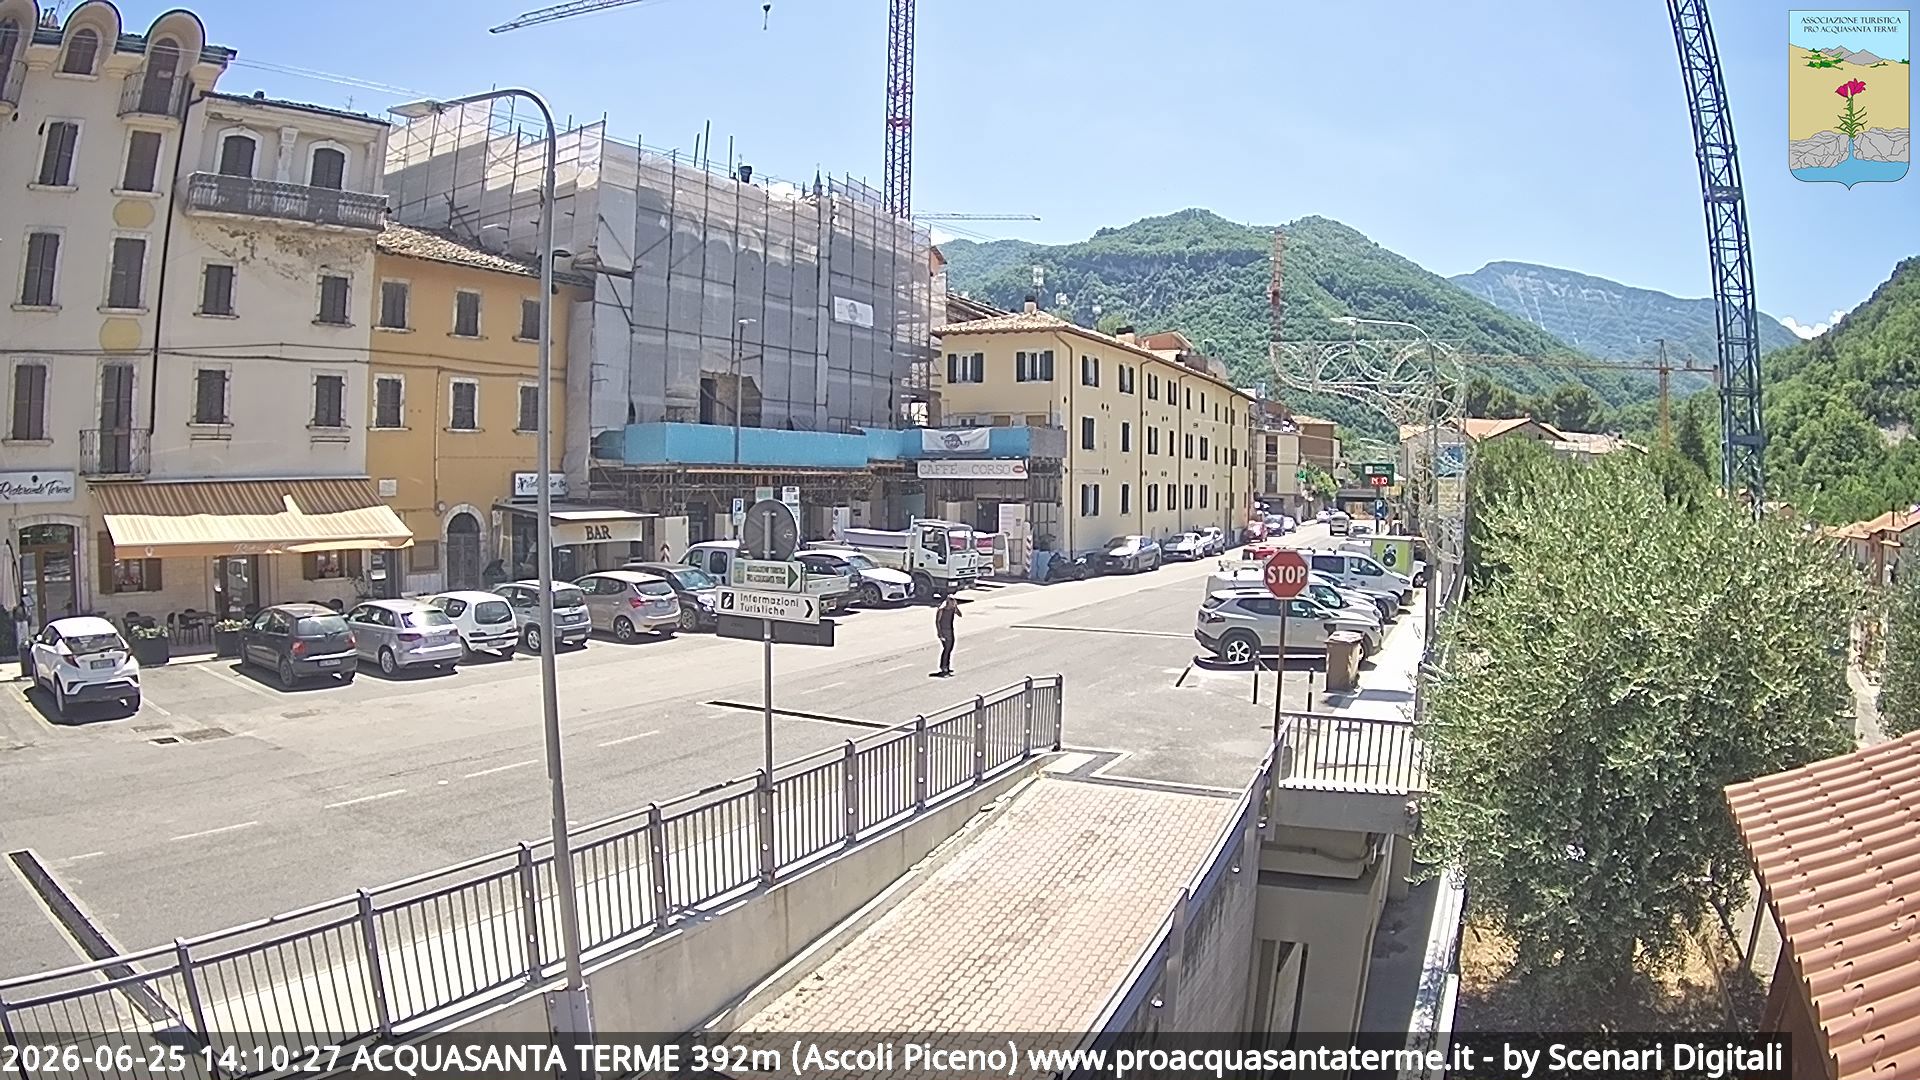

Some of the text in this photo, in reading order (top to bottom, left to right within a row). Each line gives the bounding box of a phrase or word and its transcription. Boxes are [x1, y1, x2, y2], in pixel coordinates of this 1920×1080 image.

[971, 464, 1011, 475] CORSO
[584, 525, 612, 541] BAR
[1267, 565, 1306, 584] STOP
[740, 593, 799, 608] Informazioni
[740, 603, 785, 616] Turistiche
